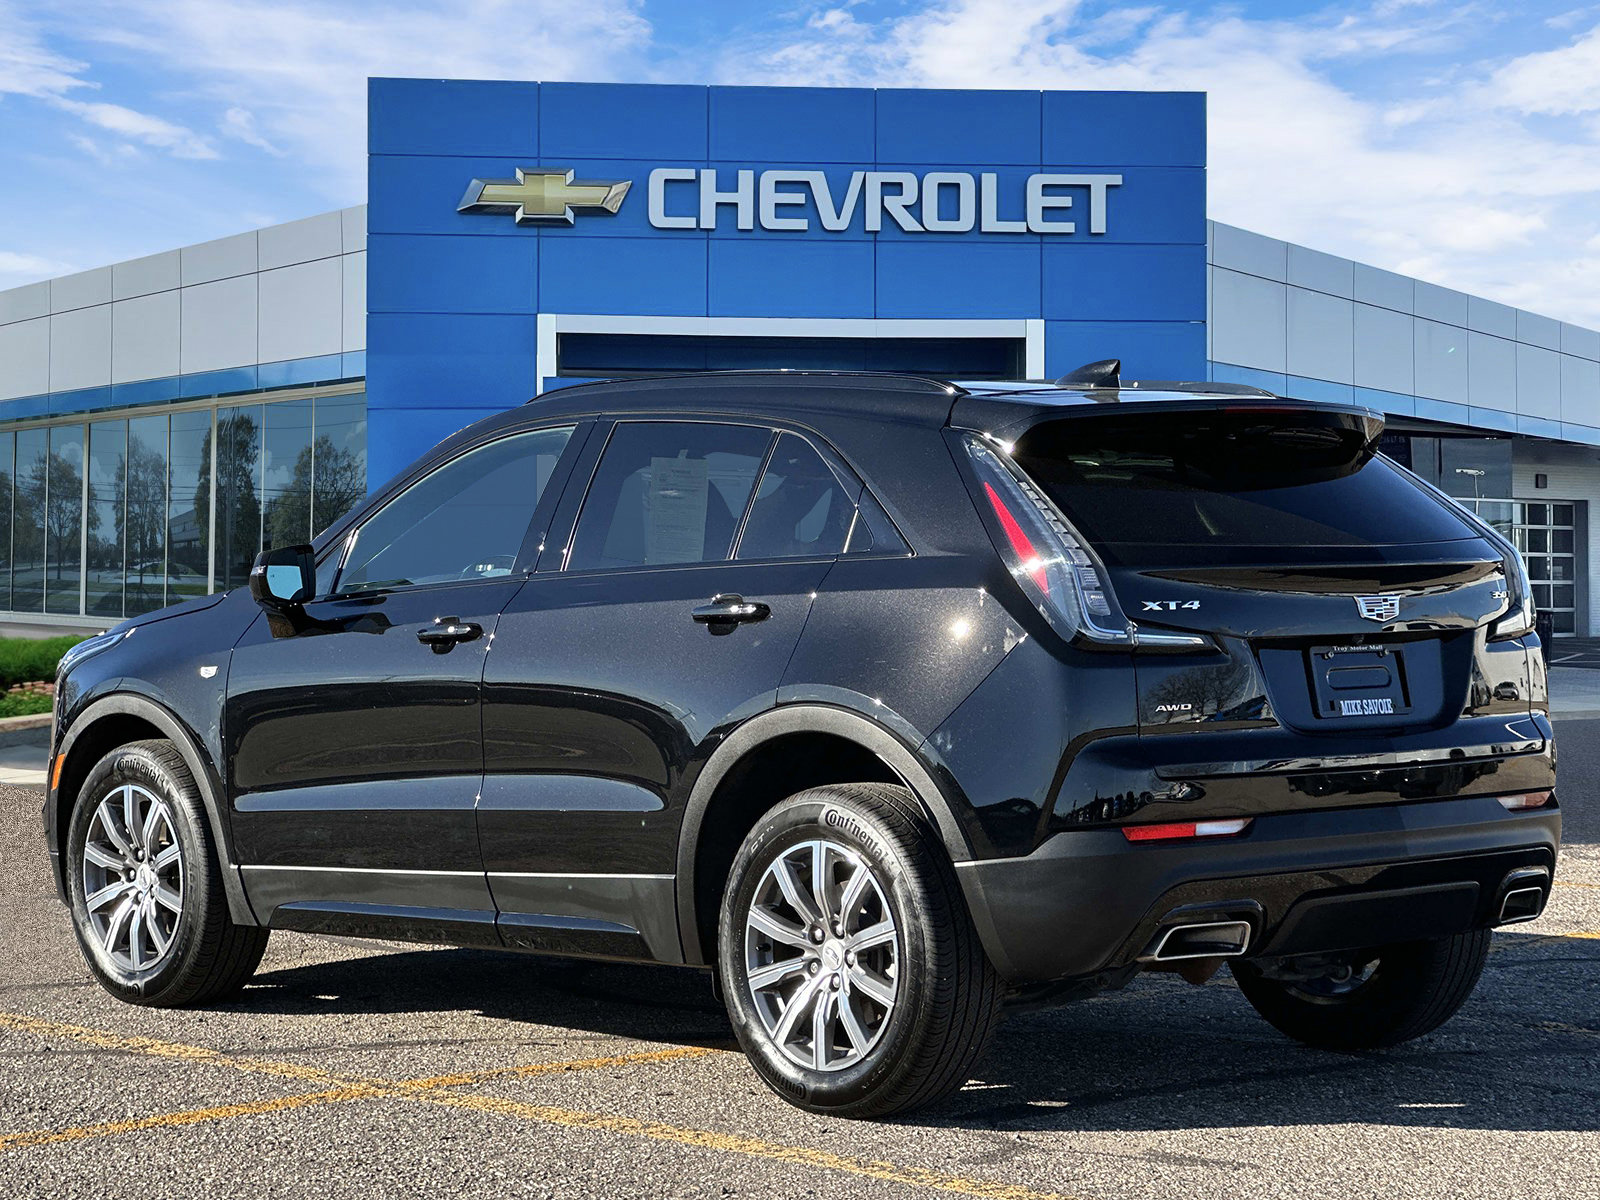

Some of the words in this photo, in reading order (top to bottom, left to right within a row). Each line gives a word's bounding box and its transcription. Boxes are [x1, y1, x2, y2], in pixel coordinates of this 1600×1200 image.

[648, 167, 1123, 234] CHEVROLET
[1141, 600, 1201, 611] XT4
[1155, 703, 1192, 712] AWD
[1340, 699, 1363, 716] MIKE
[1362, 698, 1394, 715] SAVOIE
[117, 757, 160, 783] Continental
[824, 808, 889, 863] Continental
